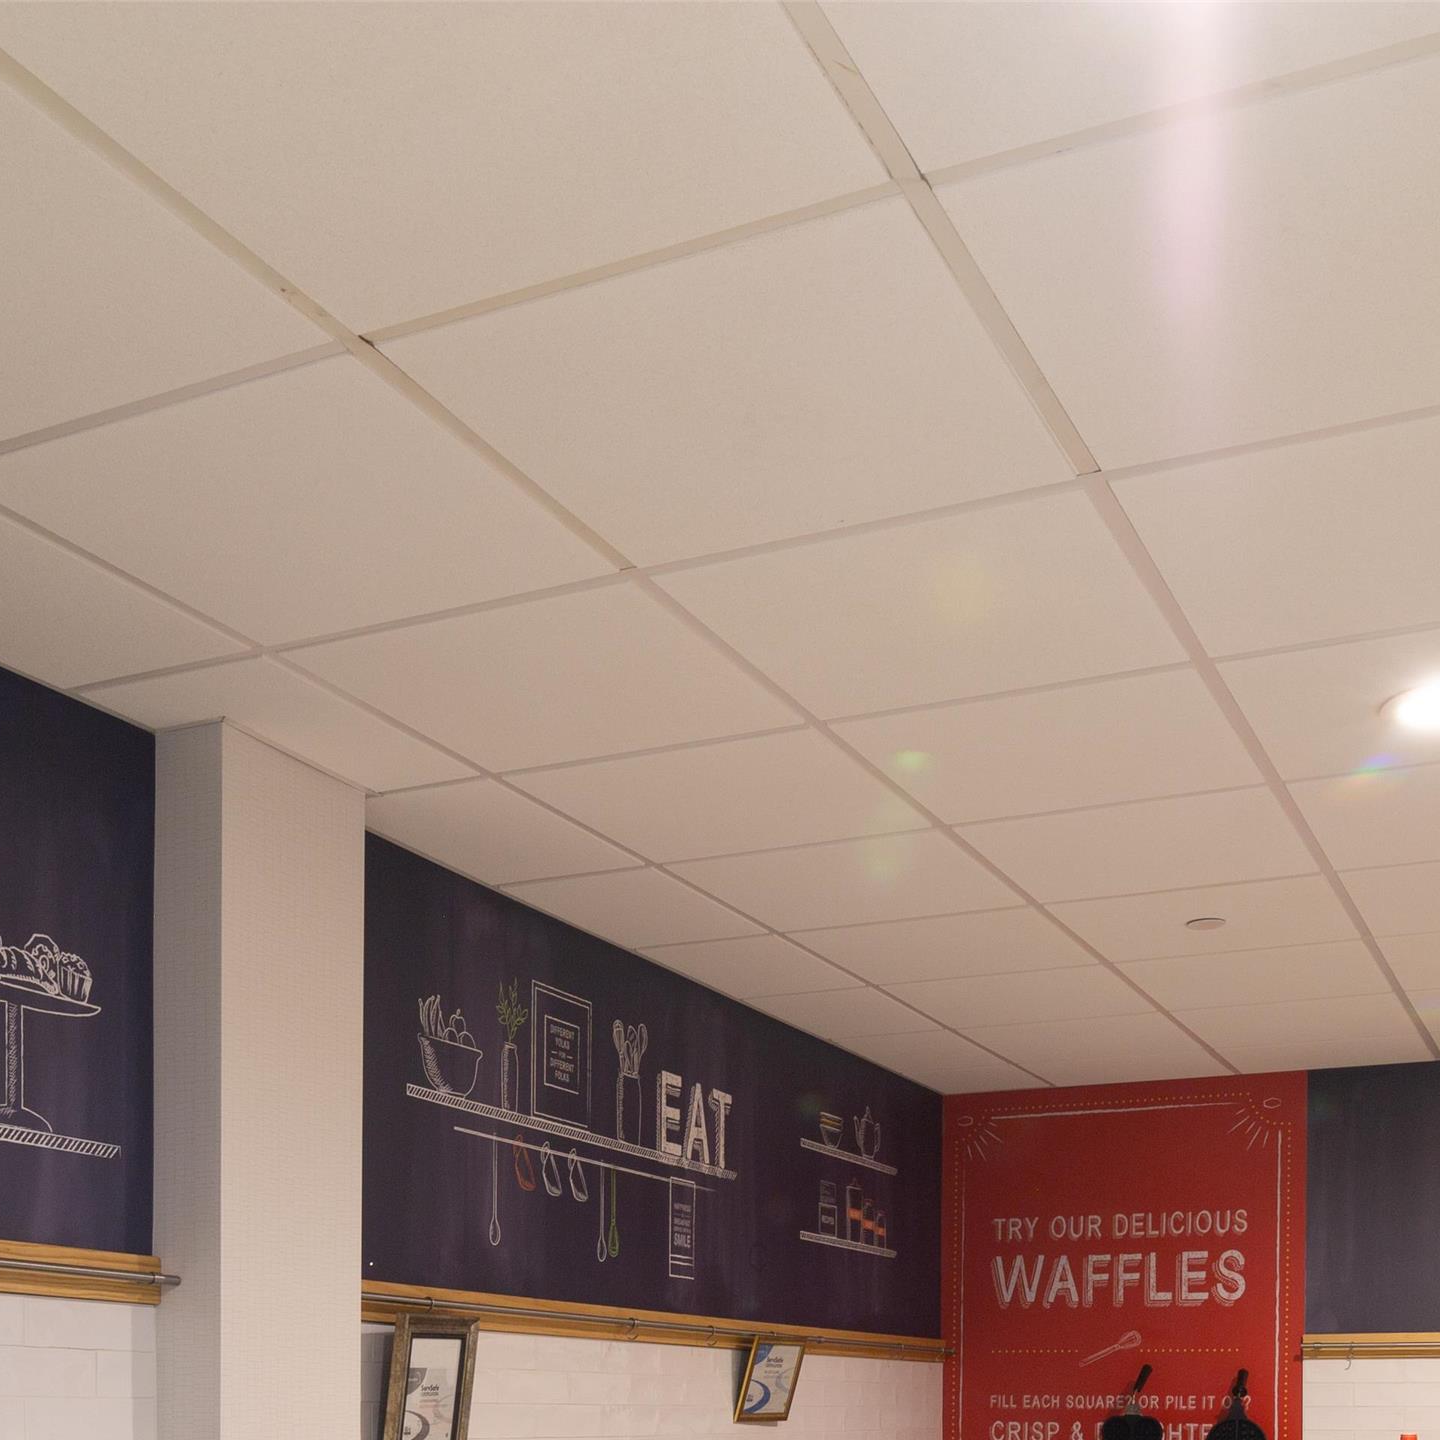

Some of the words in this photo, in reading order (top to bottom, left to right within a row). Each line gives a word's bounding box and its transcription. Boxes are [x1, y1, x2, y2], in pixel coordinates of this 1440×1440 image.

[656, 1070, 733, 1170] EAT
[992, 1216, 1039, 1241] TRY
[1049, 1214, 1102, 1240] OUR
[1112, 1209, 1248, 1239] DELICIOUS
[992, 1250, 1247, 1309] WAFFLES
[990, 1395, 1017, 1408] FILL
[1023, 1395, 1060, 1409] EACH
[1138, 1396, 1159, 1409] OR
[1165, 1396, 1197, 1410] PILE
[1202, 1396, 1215, 1410] IT
[1221, 1396, 1252, 1410] O?
